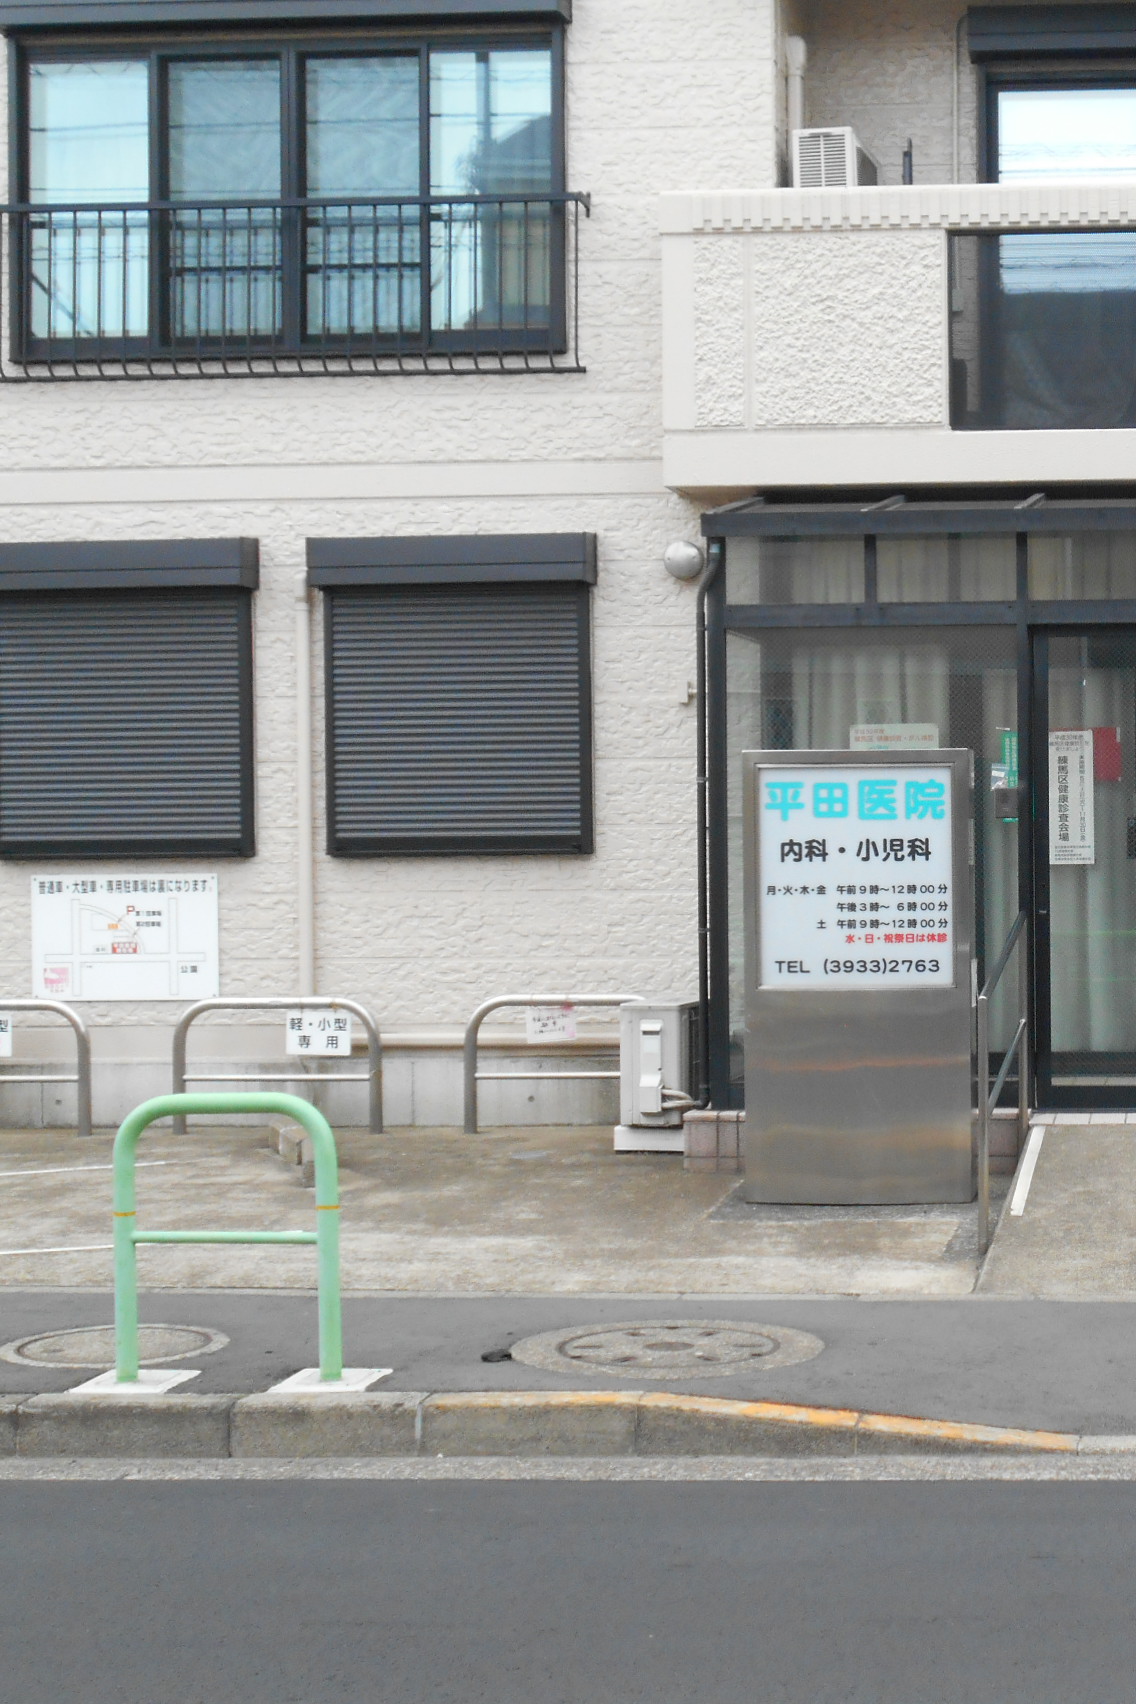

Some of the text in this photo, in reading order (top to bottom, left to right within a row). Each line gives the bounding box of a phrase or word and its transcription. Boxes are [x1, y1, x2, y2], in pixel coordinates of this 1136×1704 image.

[764, 778, 946, 822] 平田医院
[1057, 755, 1069, 841] 練馬区健康診査会場
[780, 837, 932, 863] 内科・小児科
[766, 885, 827, 896] 月・火・木・金
[816, 919, 827, 929] 土
[845, 933, 948, 944] 水・日・祝祭日は休診
[775, 958, 941, 975] TEL (3933)2763
[289, 1017, 347, 1032] 軽・小型
[298, 1035, 338, 1048] 専用
